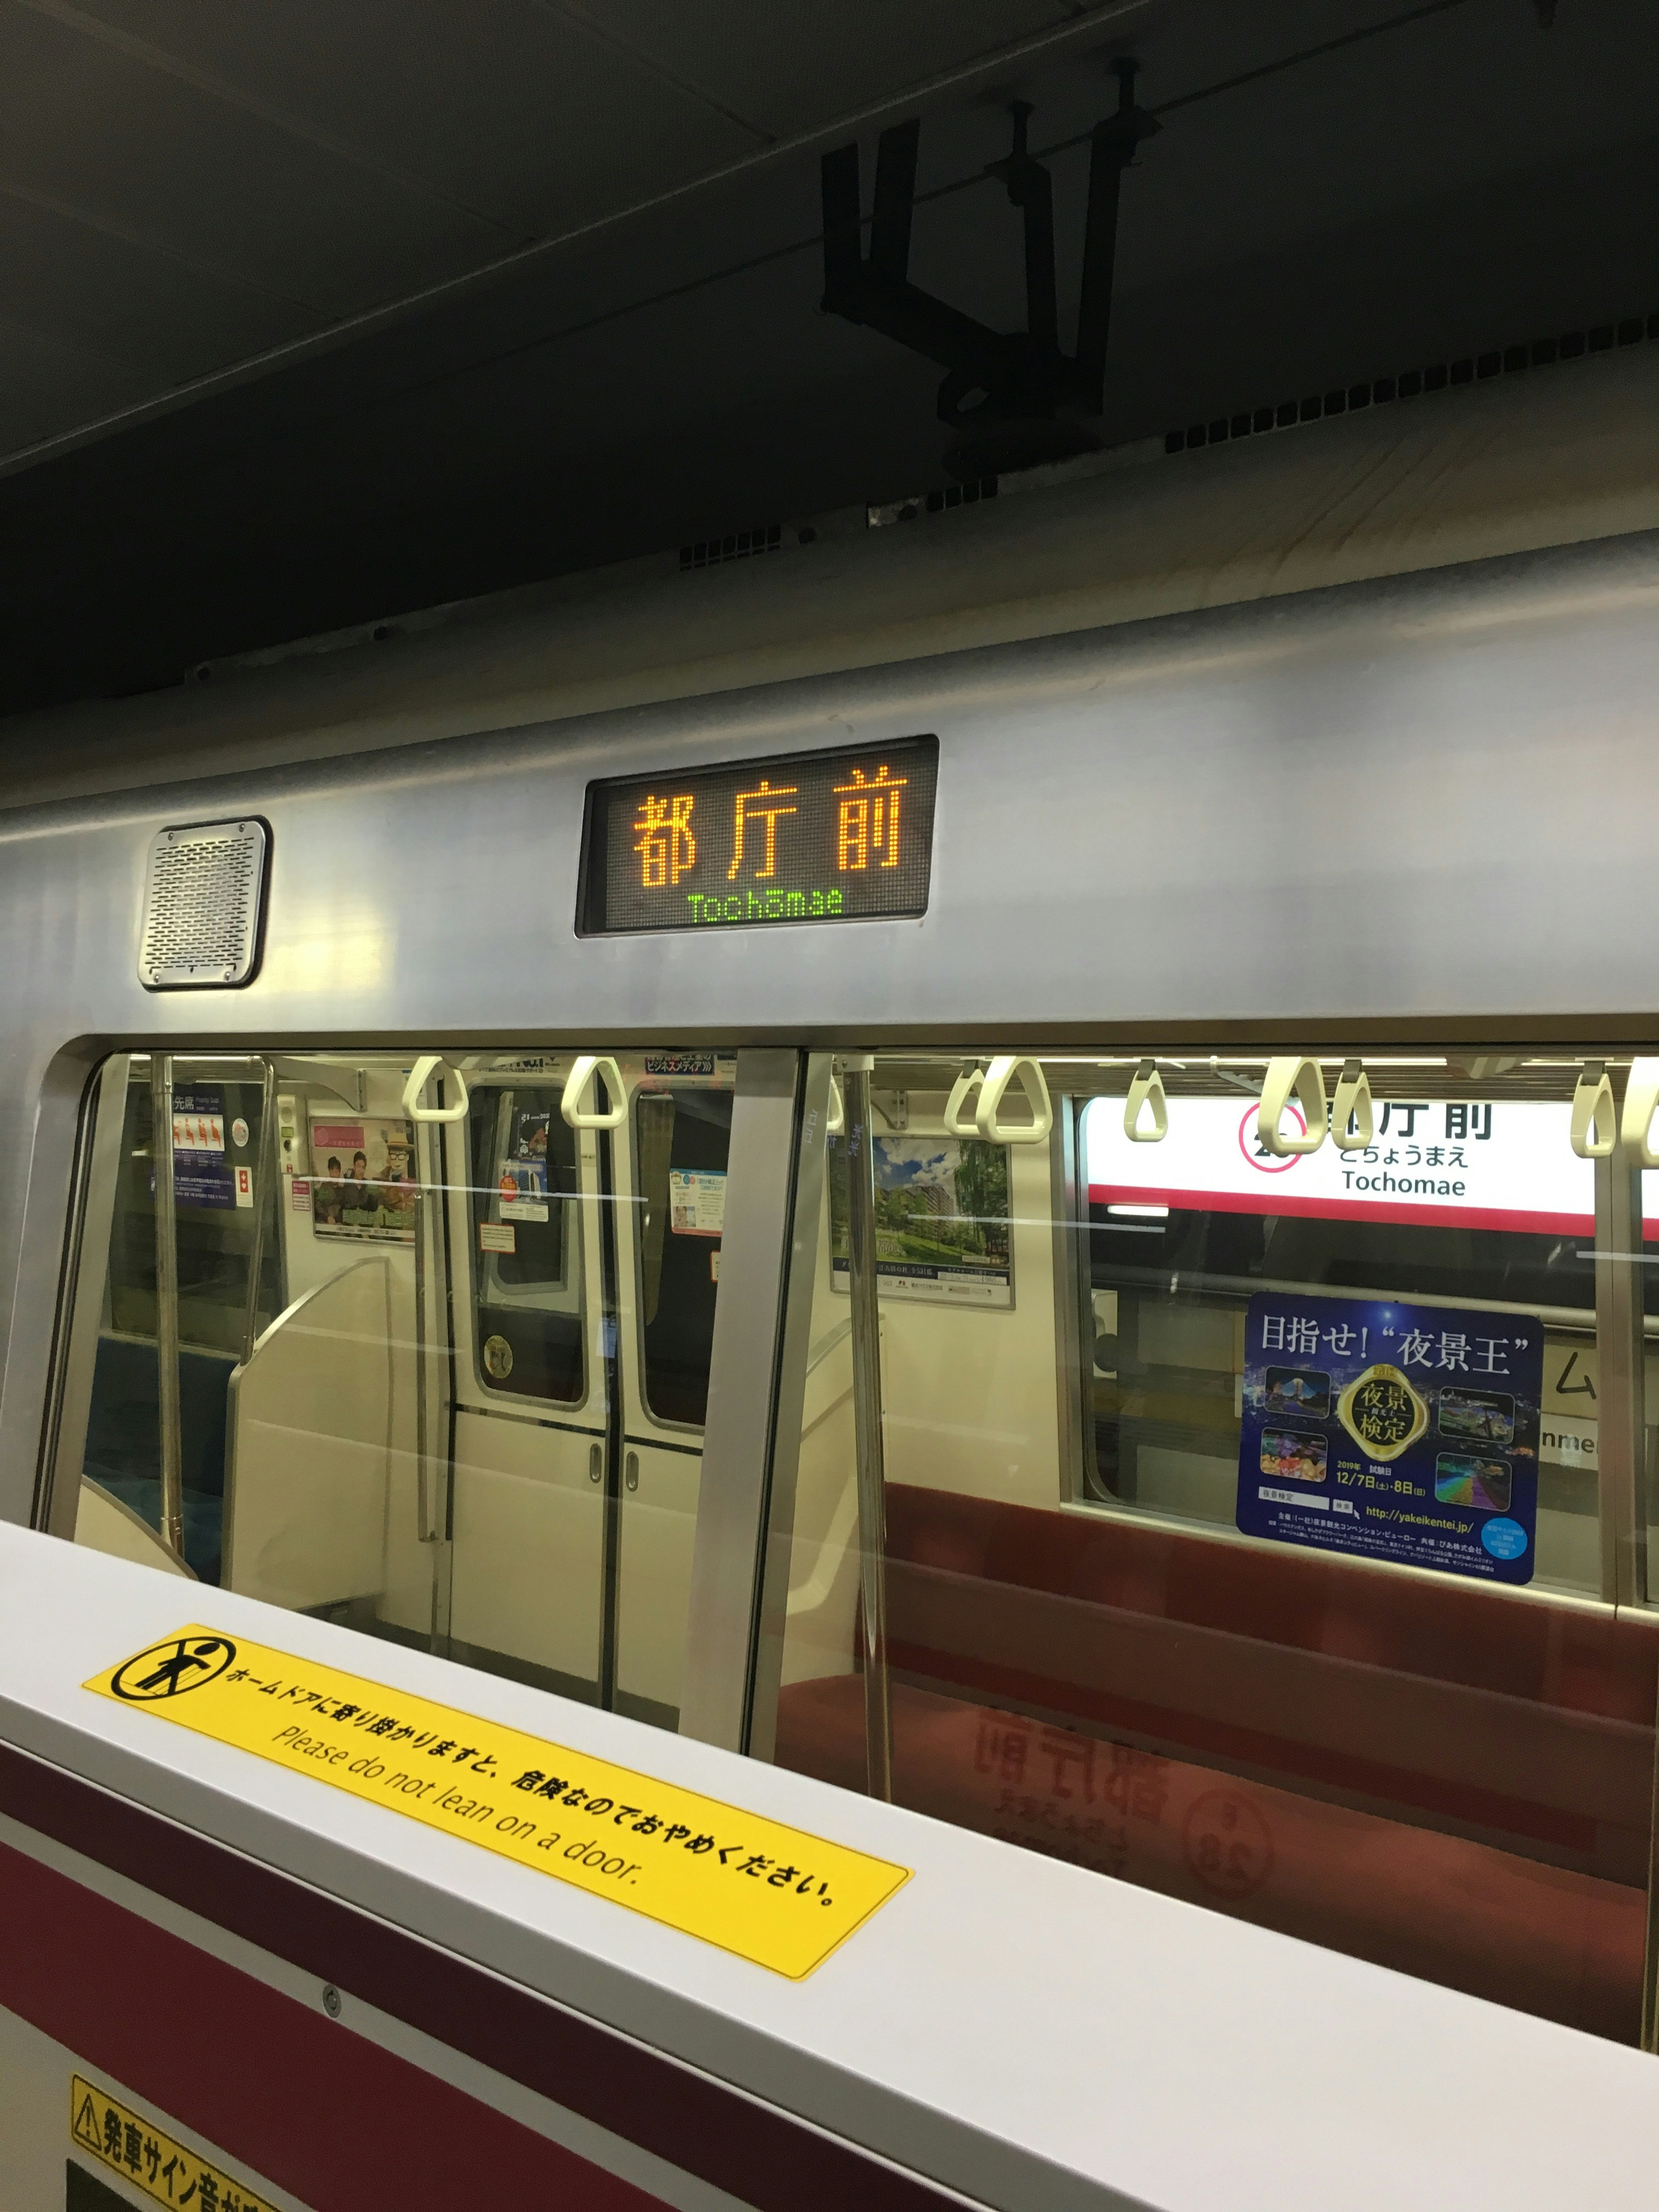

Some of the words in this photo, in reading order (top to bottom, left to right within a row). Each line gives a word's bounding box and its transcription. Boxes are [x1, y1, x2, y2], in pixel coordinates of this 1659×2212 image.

[633, 765, 909, 887] 都庁前
[173, 1096, 194, 1110] 先席
[1328, 1102, 1493, 1141] 庁前
[1341, 1171, 1466, 1197] Tochomae
[1361, 1383, 1408, 1412] 夜景
[1360, 1413, 1406, 1442] 検定
[1365, 1505, 1475, 1534] http://yakeikentei.jp/
[272, 1725, 348, 1765] Please
[348, 1756, 386, 1780] do
[384, 1771, 436, 1799] not
[432, 1785, 495, 1824] lean
[495, 1815, 539, 1840] on
[538, 1833, 561, 1849] a
[563, 1841, 643, 1885] door.
